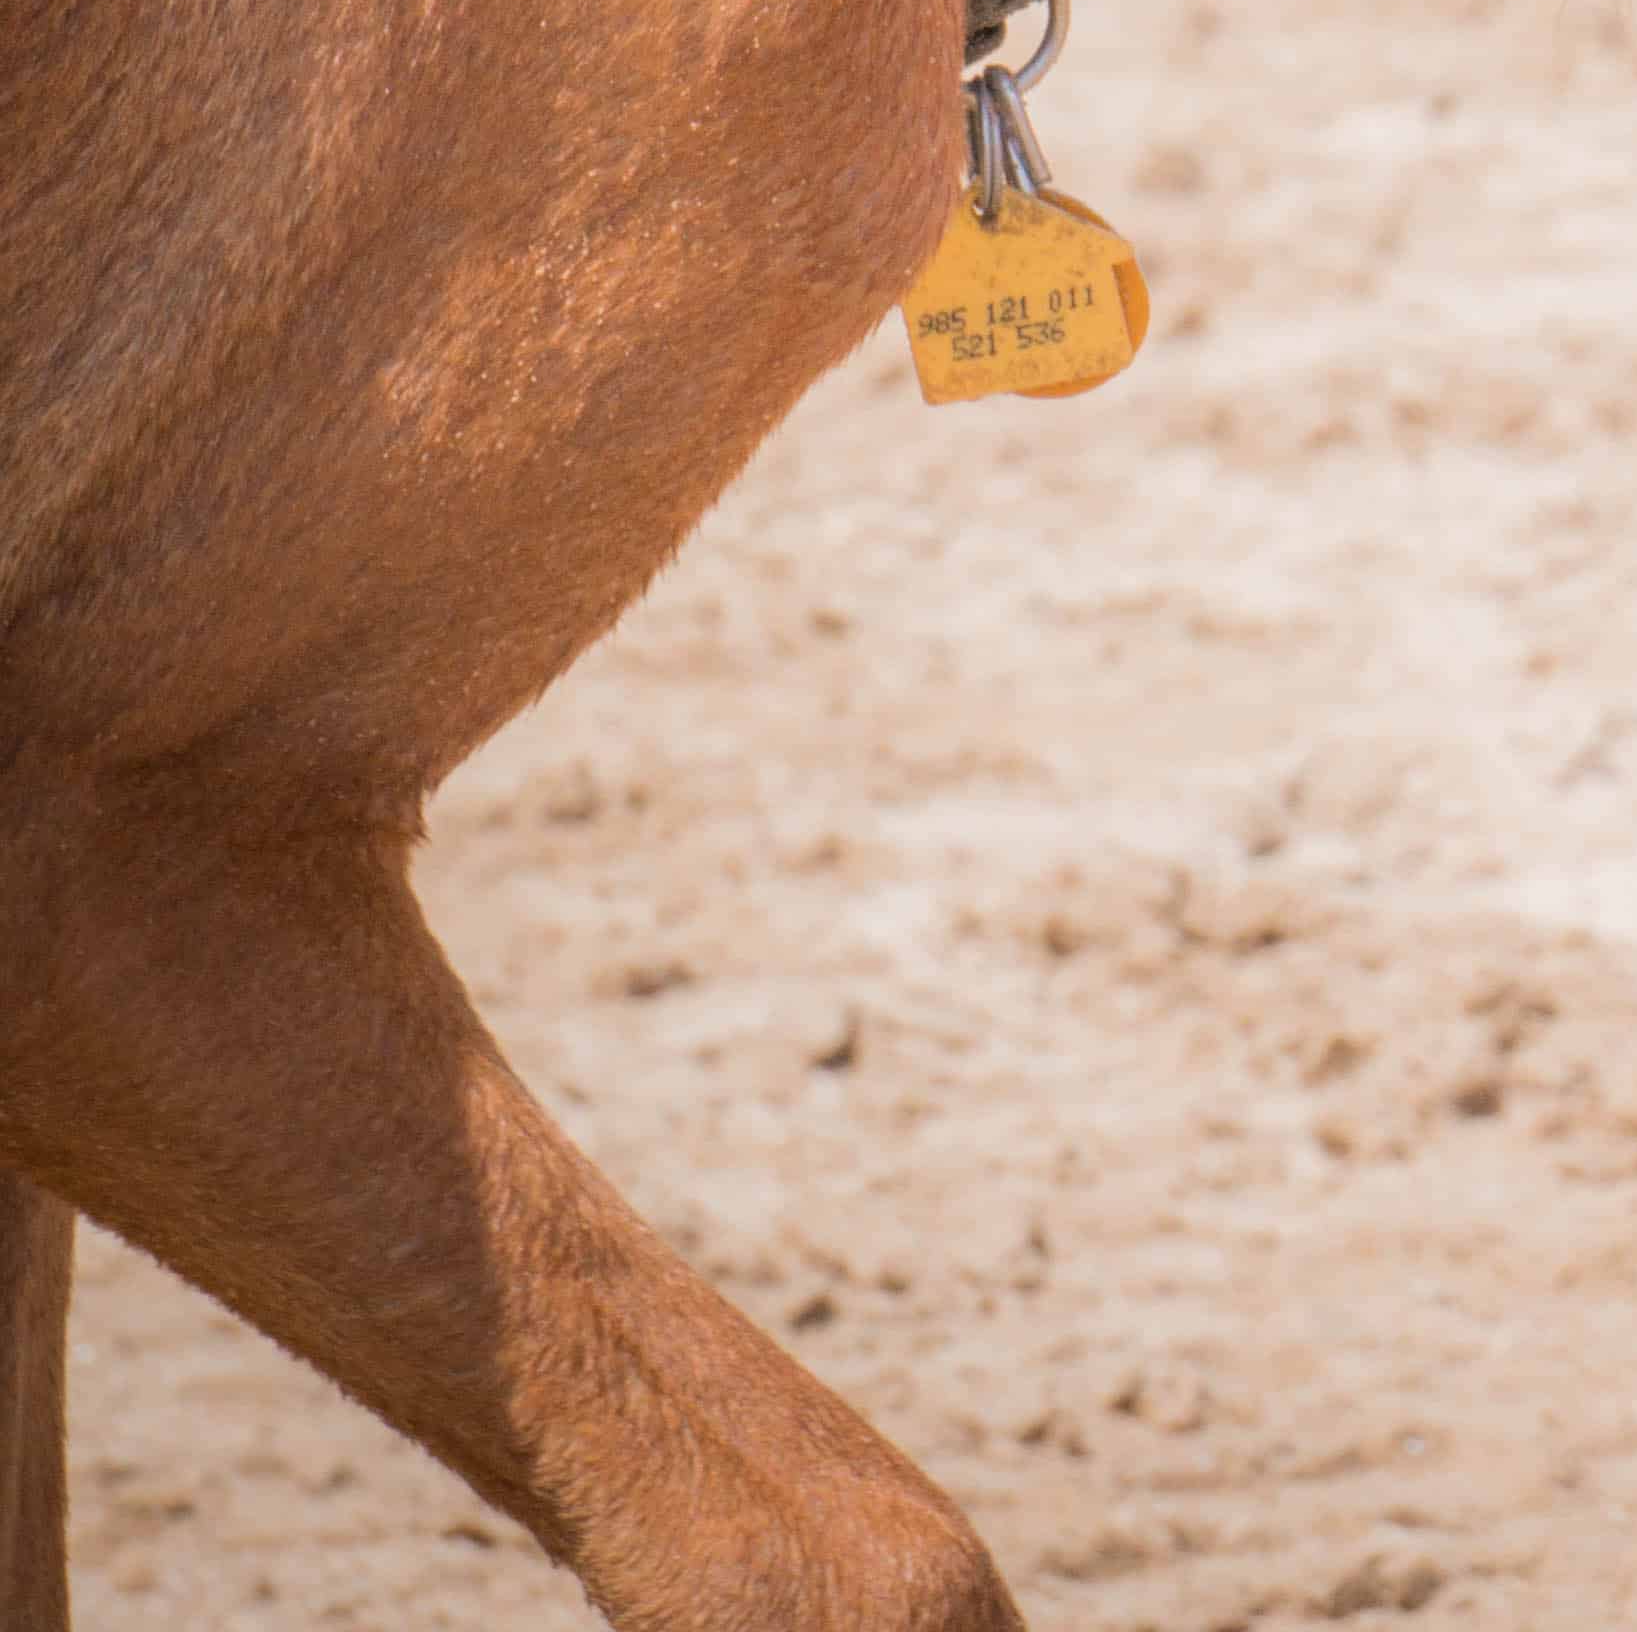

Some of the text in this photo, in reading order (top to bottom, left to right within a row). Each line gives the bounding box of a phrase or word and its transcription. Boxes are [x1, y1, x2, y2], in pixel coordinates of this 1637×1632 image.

[917, 287, 1096, 338] 985 121 011
[952, 318, 1066, 362] 521 536
